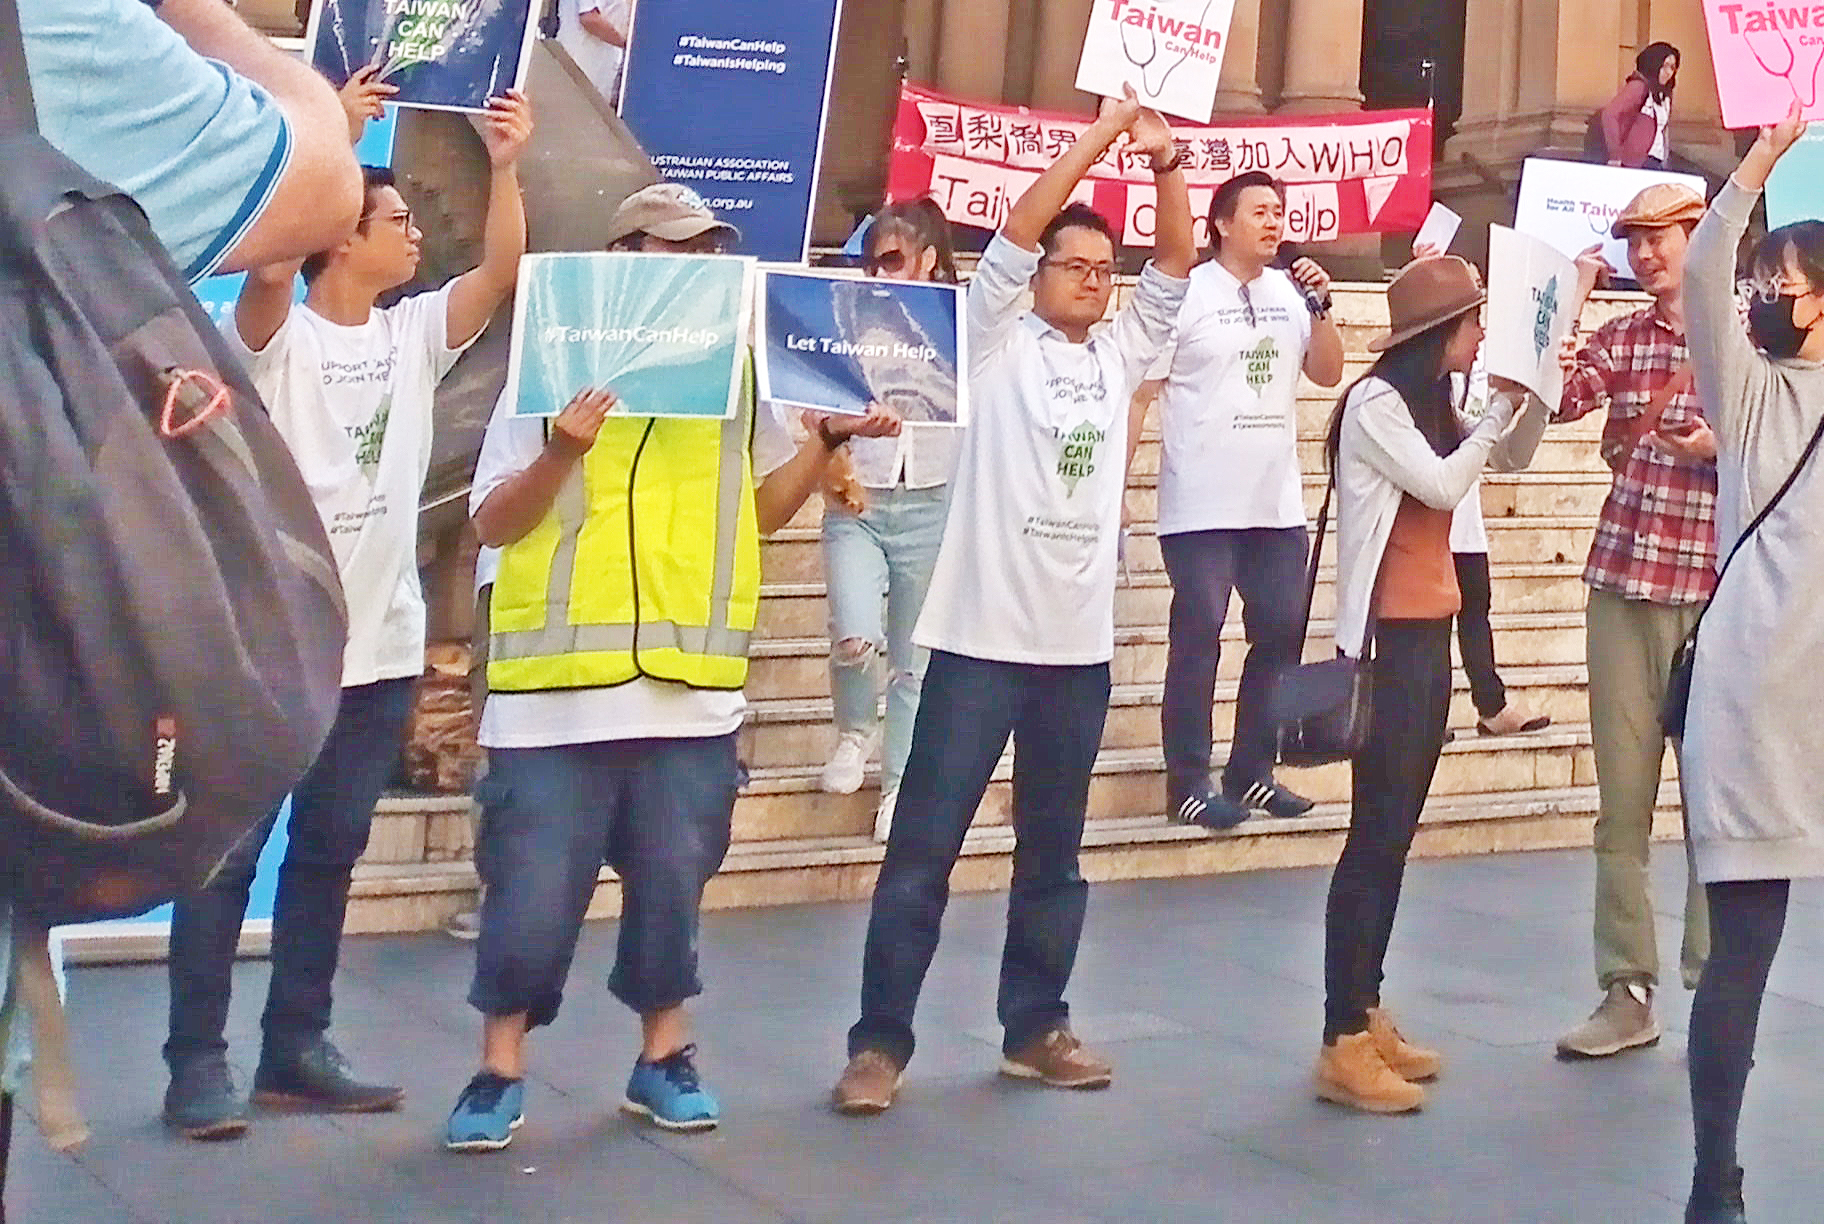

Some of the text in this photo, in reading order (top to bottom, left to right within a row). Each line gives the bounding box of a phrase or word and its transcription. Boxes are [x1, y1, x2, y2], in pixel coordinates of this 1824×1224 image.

[398, 21, 444, 39] CAN
[678, 35, 787, 55] #TaiwanCanHelp
[1799, 34, 1824, 47] Can
[387, 40, 446, 62] HELP
[1165, 41, 1218, 65] Can Help
[673, 53, 787, 74] #TaiwanIsHelping
[651, 155, 790, 171] USTRALIAN ASSOCIATION
[660, 168, 794, 184] TAIWAN PUBLIC AFFAIRS
[701, 197, 754, 211] n.org.au
[1546, 197, 1576, 207] Health
[1562, 204, 1576, 213] All
[1579, 200, 1625, 219] Taiw
[1289, 199, 1337, 237] elp
[544, 325, 721, 351] #TaiwanCanHelp
[787, 334, 938, 363] Let Taiwan Help
[1240, 349, 1279, 360] TAIWAN
[1248, 361, 1270, 372] CAN
[1246, 374, 1273, 385] HELP
[1064, 445, 1093, 460] CAN
[1056, 462, 1095, 478] HELP
